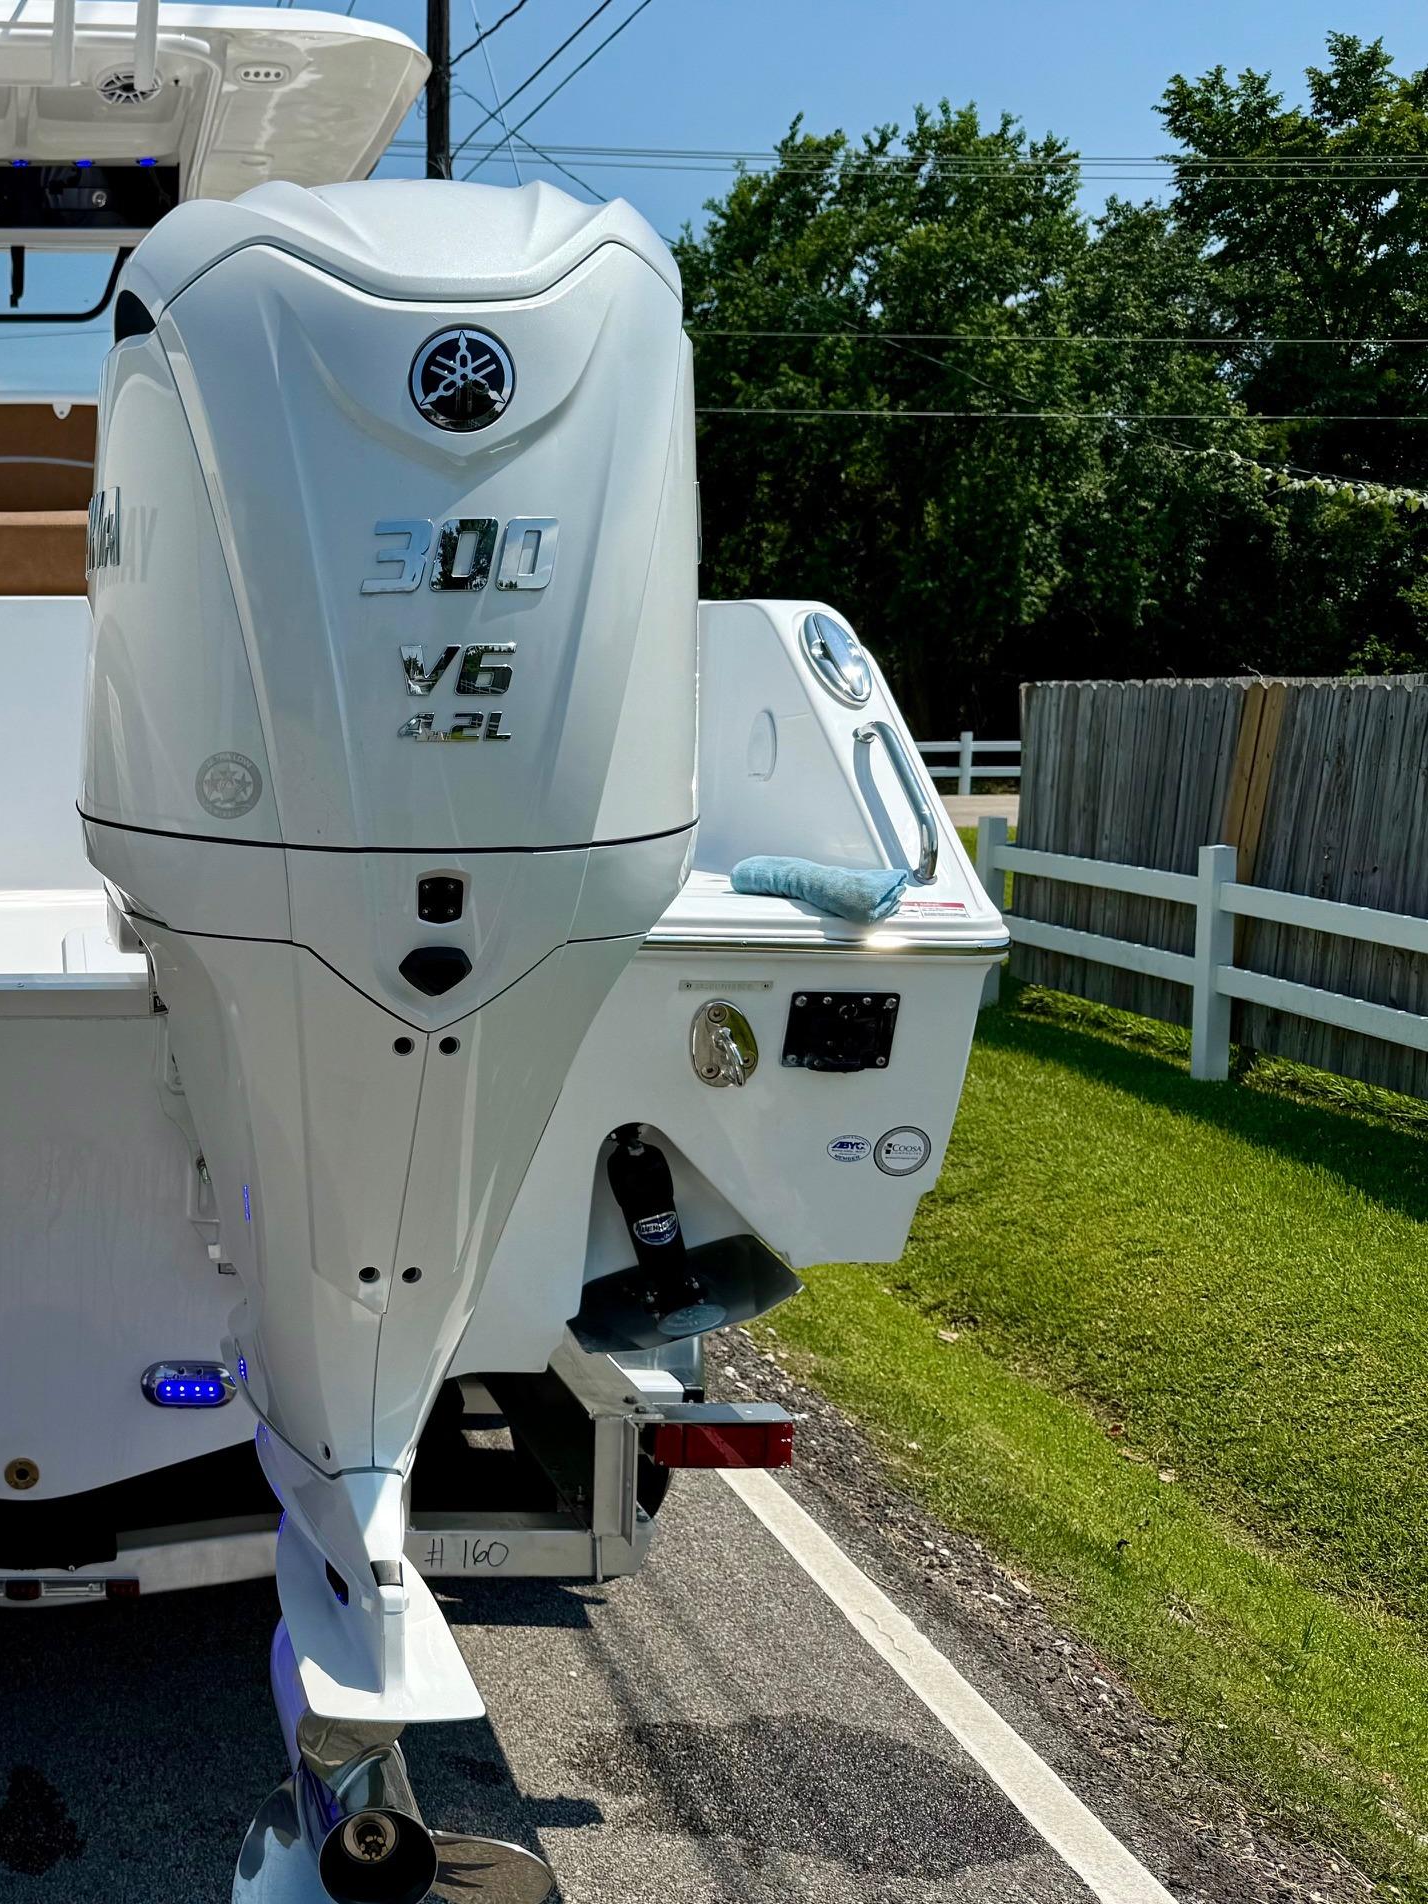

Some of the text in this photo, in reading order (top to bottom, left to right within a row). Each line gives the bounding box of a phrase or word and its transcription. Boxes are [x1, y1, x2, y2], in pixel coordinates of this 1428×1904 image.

[360, 516, 559, 594] 300
[401, 642, 517, 696] V6
[397, 711, 512, 742] 4.2L
[831, 1141, 865, 1150] ABYC
[892, 1143, 922, 1152] COOSA
[463, 1539, 509, 1568] 160
